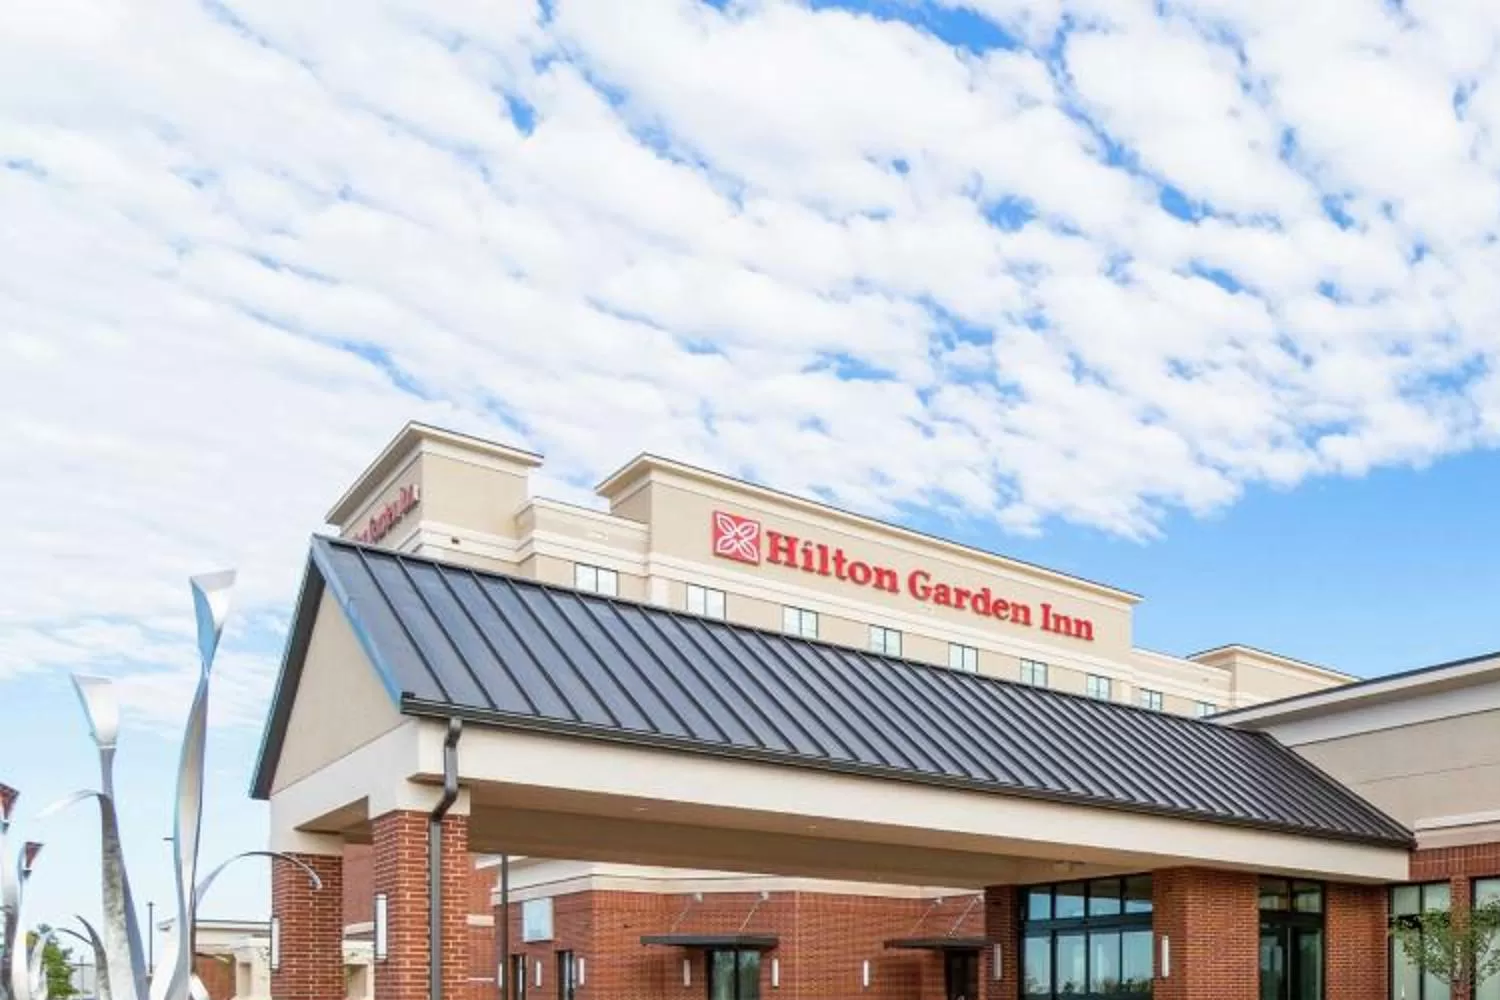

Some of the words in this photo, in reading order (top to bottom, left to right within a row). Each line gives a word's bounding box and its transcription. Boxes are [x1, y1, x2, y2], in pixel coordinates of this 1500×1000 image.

[766, 530, 900, 593] Hilton
[907, 569, 1031, 626] Garden
[1040, 602, 1094, 641] Inn
